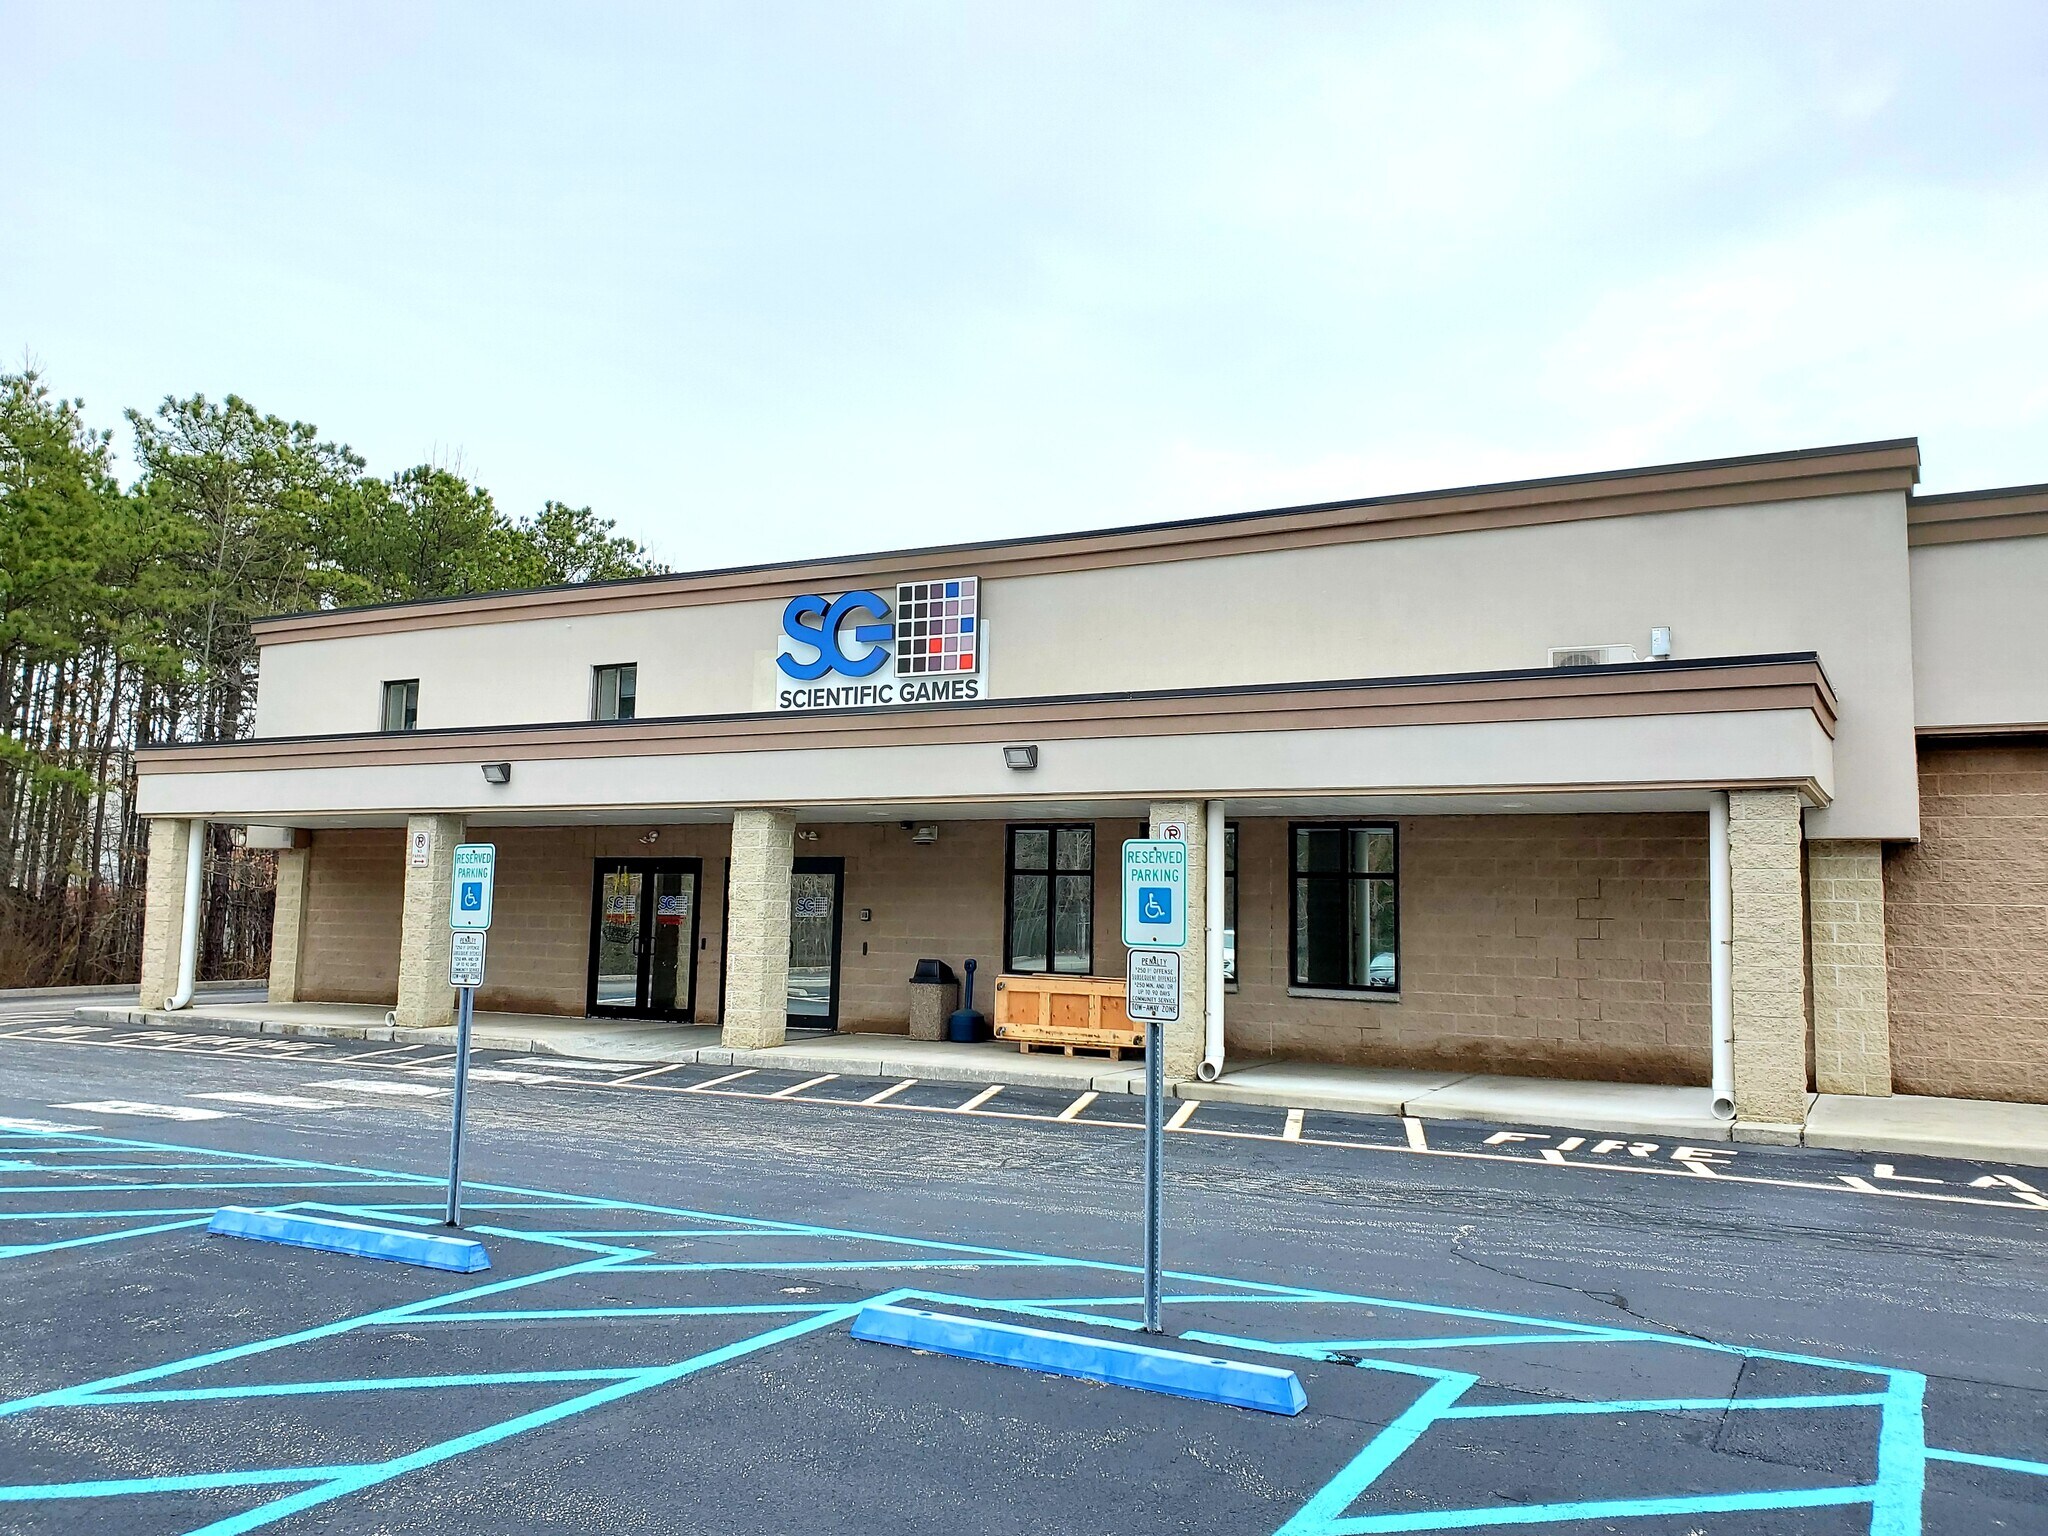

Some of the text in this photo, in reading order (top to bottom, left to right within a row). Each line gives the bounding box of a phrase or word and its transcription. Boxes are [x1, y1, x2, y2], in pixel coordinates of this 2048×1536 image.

[776, 590, 894, 680] SG
[780, 679, 979, 709] SCIENTIFIC GAMES
[456, 853, 492, 864] RESERVED
[1127, 850, 1183, 864] RESERVED
[457, 867, 488, 879] PARKING
[1131, 869, 1179, 882] PARKING
[1142, 958, 1167, 966] PENALTY
[1132, 1003, 1160, 1011] TOW-AWAY
[1482, 1131, 1739, 1165] FIRE
